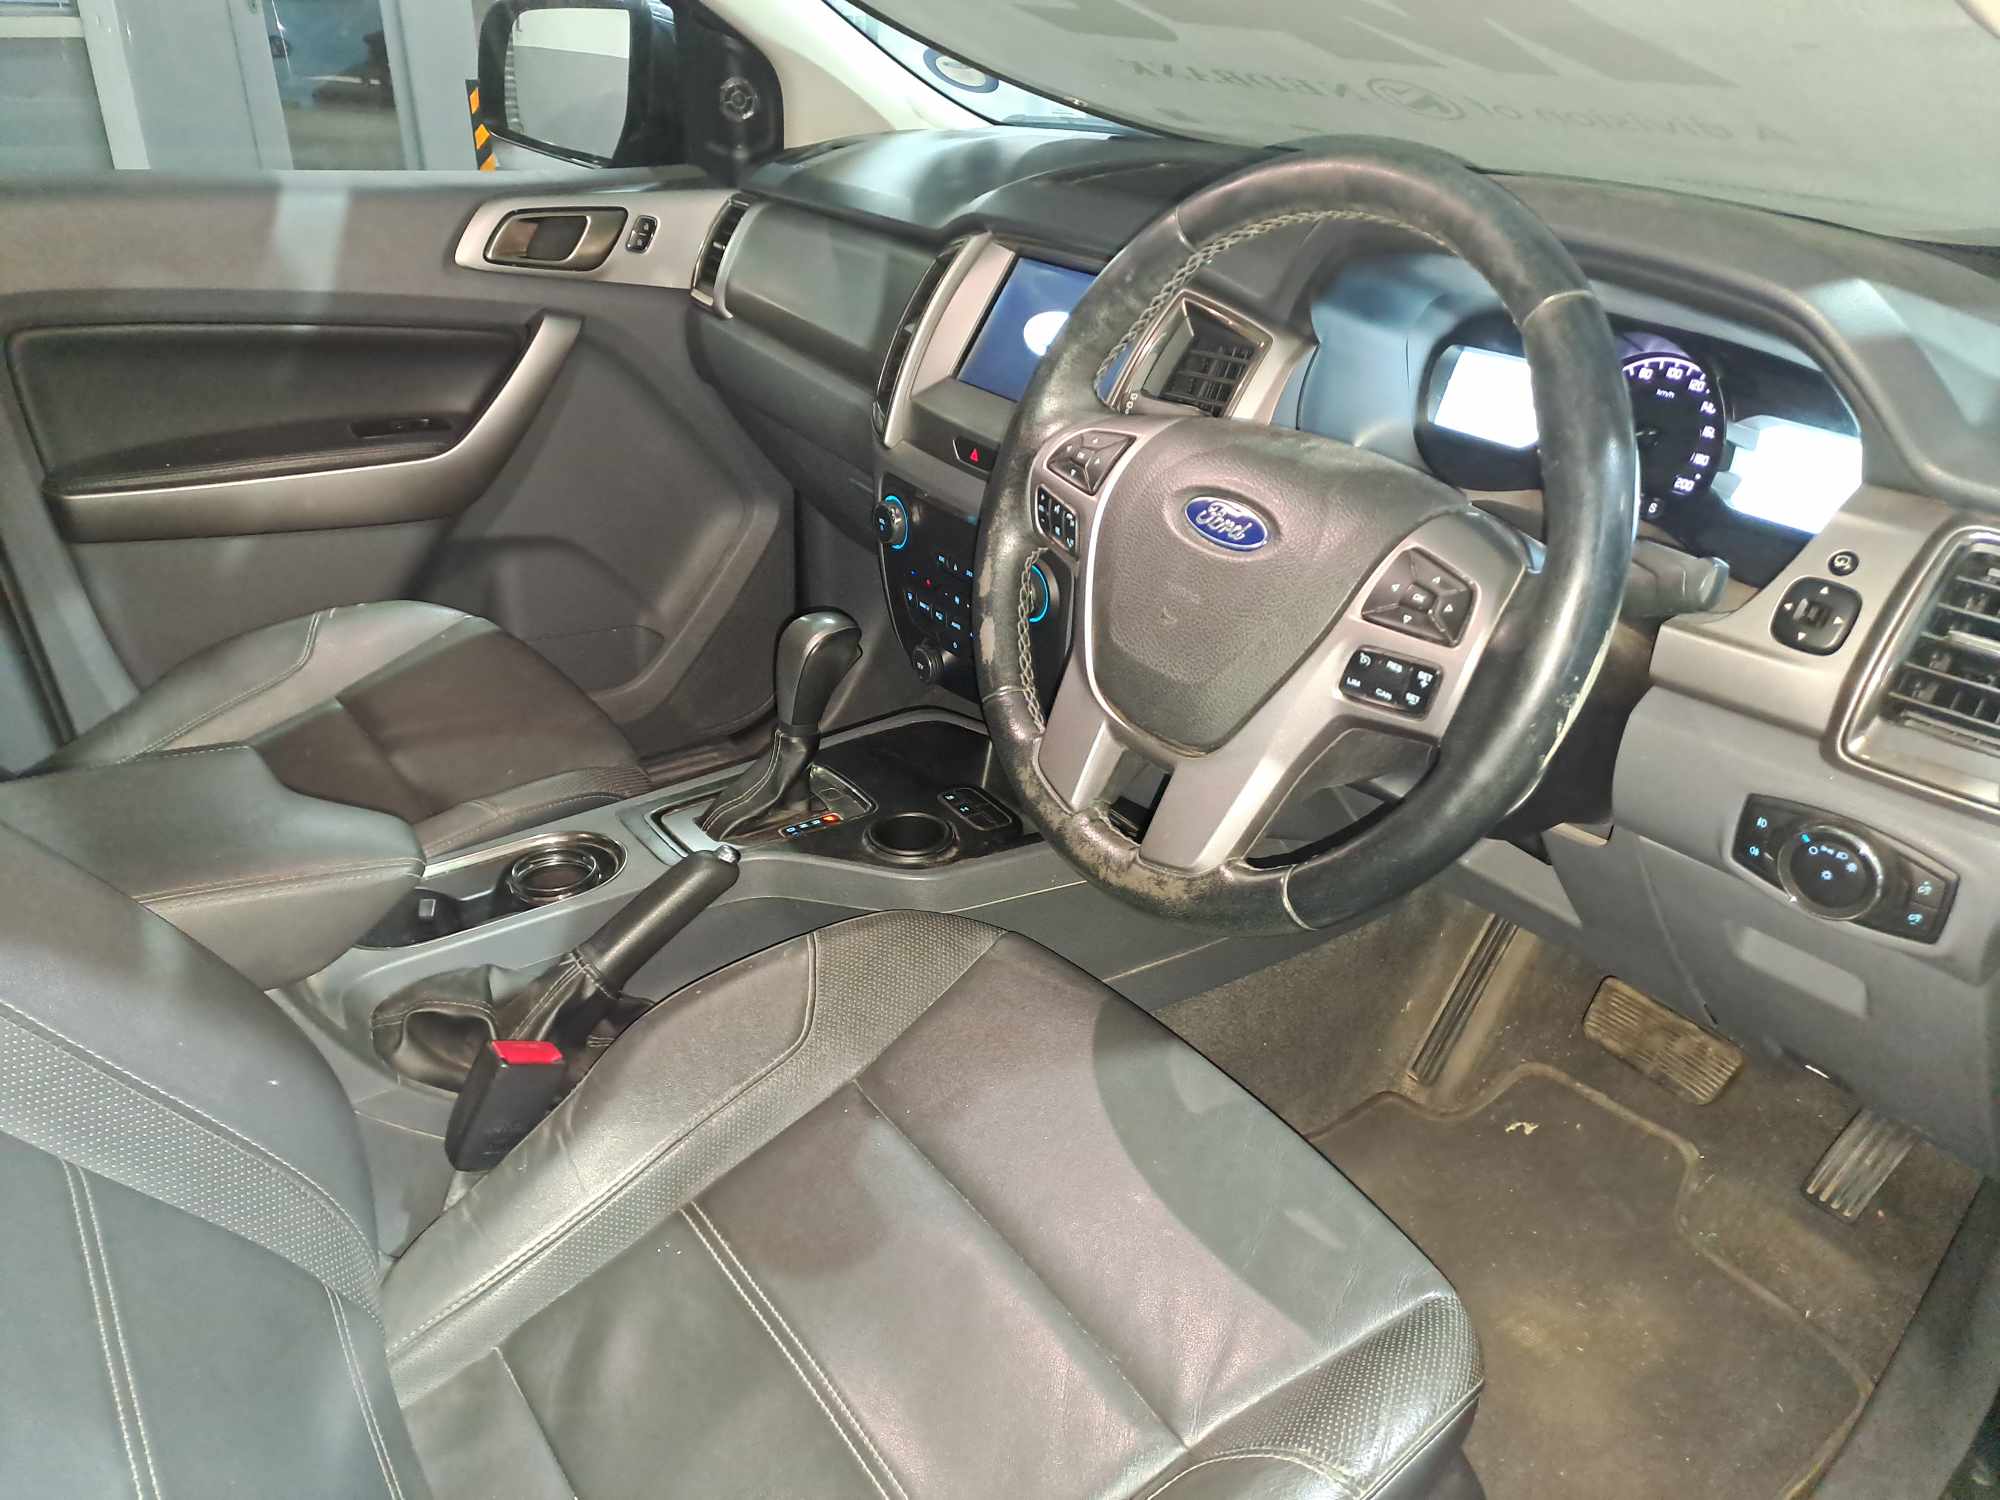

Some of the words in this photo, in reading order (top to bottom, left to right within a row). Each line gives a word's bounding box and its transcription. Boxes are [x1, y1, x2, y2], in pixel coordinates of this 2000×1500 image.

[1665, 367, 1684, 380] 100
[1688, 379, 1706, 393] 120
[1674, 477, 1695, 492] 200
[1195, 501, 1252, 542] Ford
